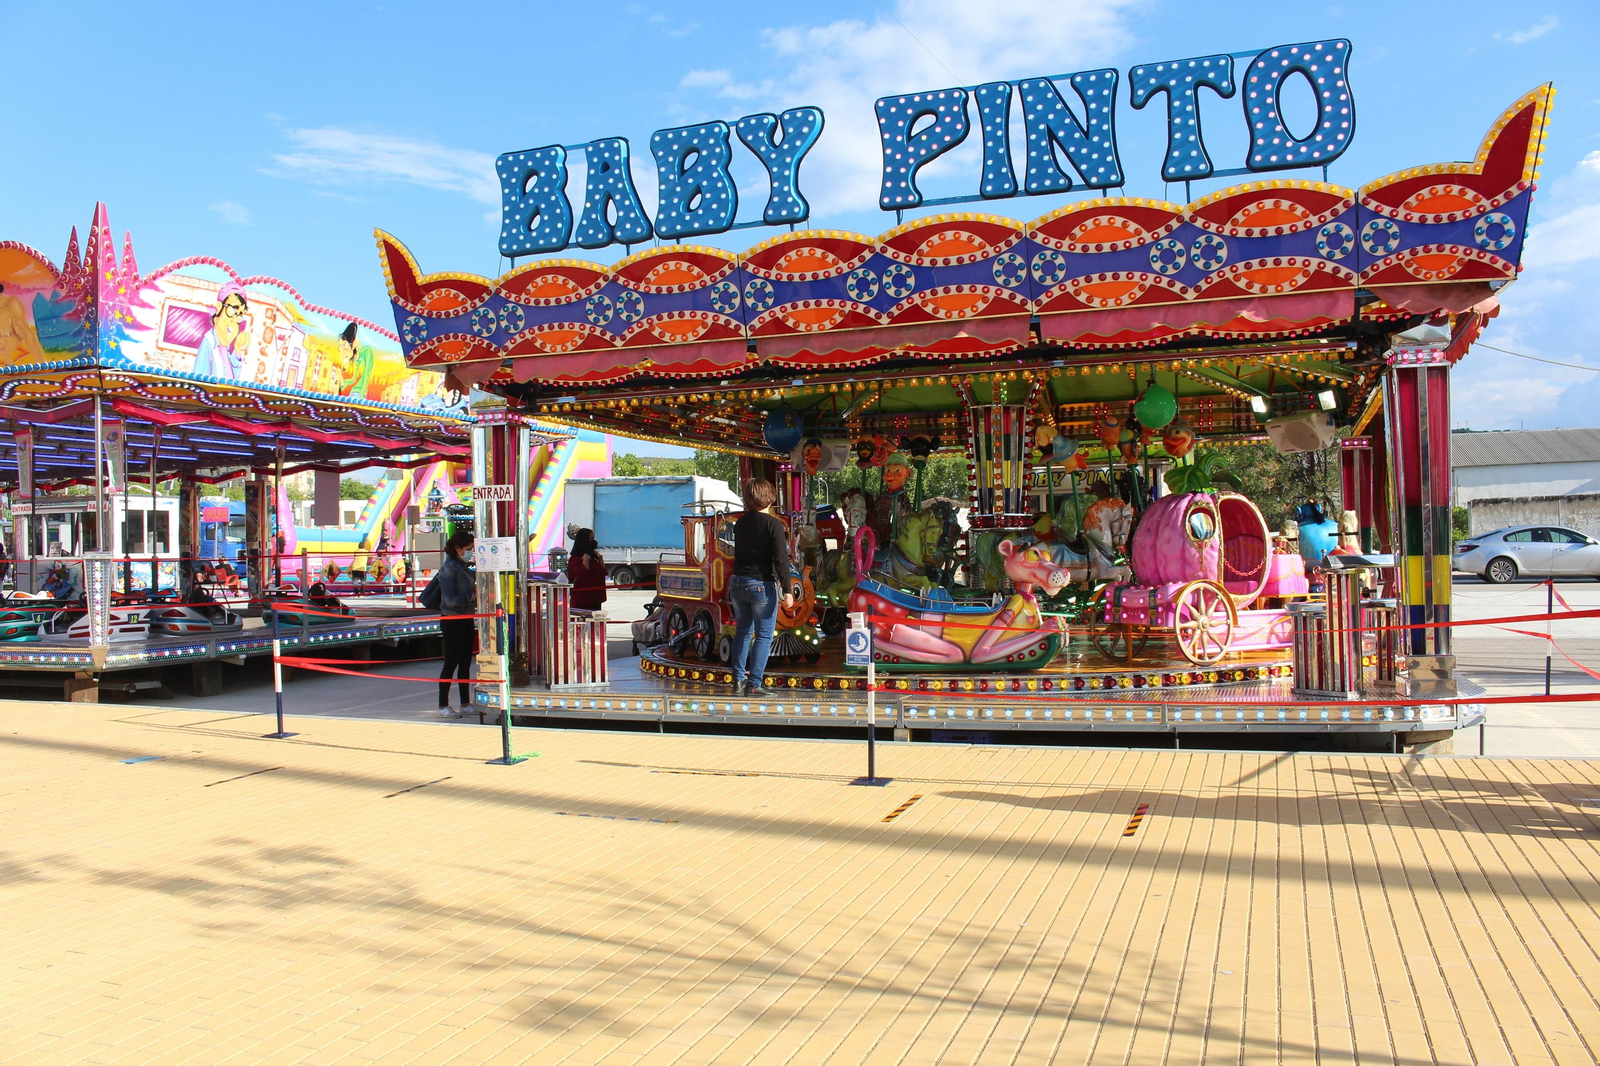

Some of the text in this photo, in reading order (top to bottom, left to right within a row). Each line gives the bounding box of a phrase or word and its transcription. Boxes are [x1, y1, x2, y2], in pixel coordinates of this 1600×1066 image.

[495, 39, 1356, 257] BABY PINTO
[473, 486, 512, 500] ENTRADA
[12, 505, 32, 513] ENTRADA
[36, 614, 41, 623] 4
[130, 614, 138, 623] 12
